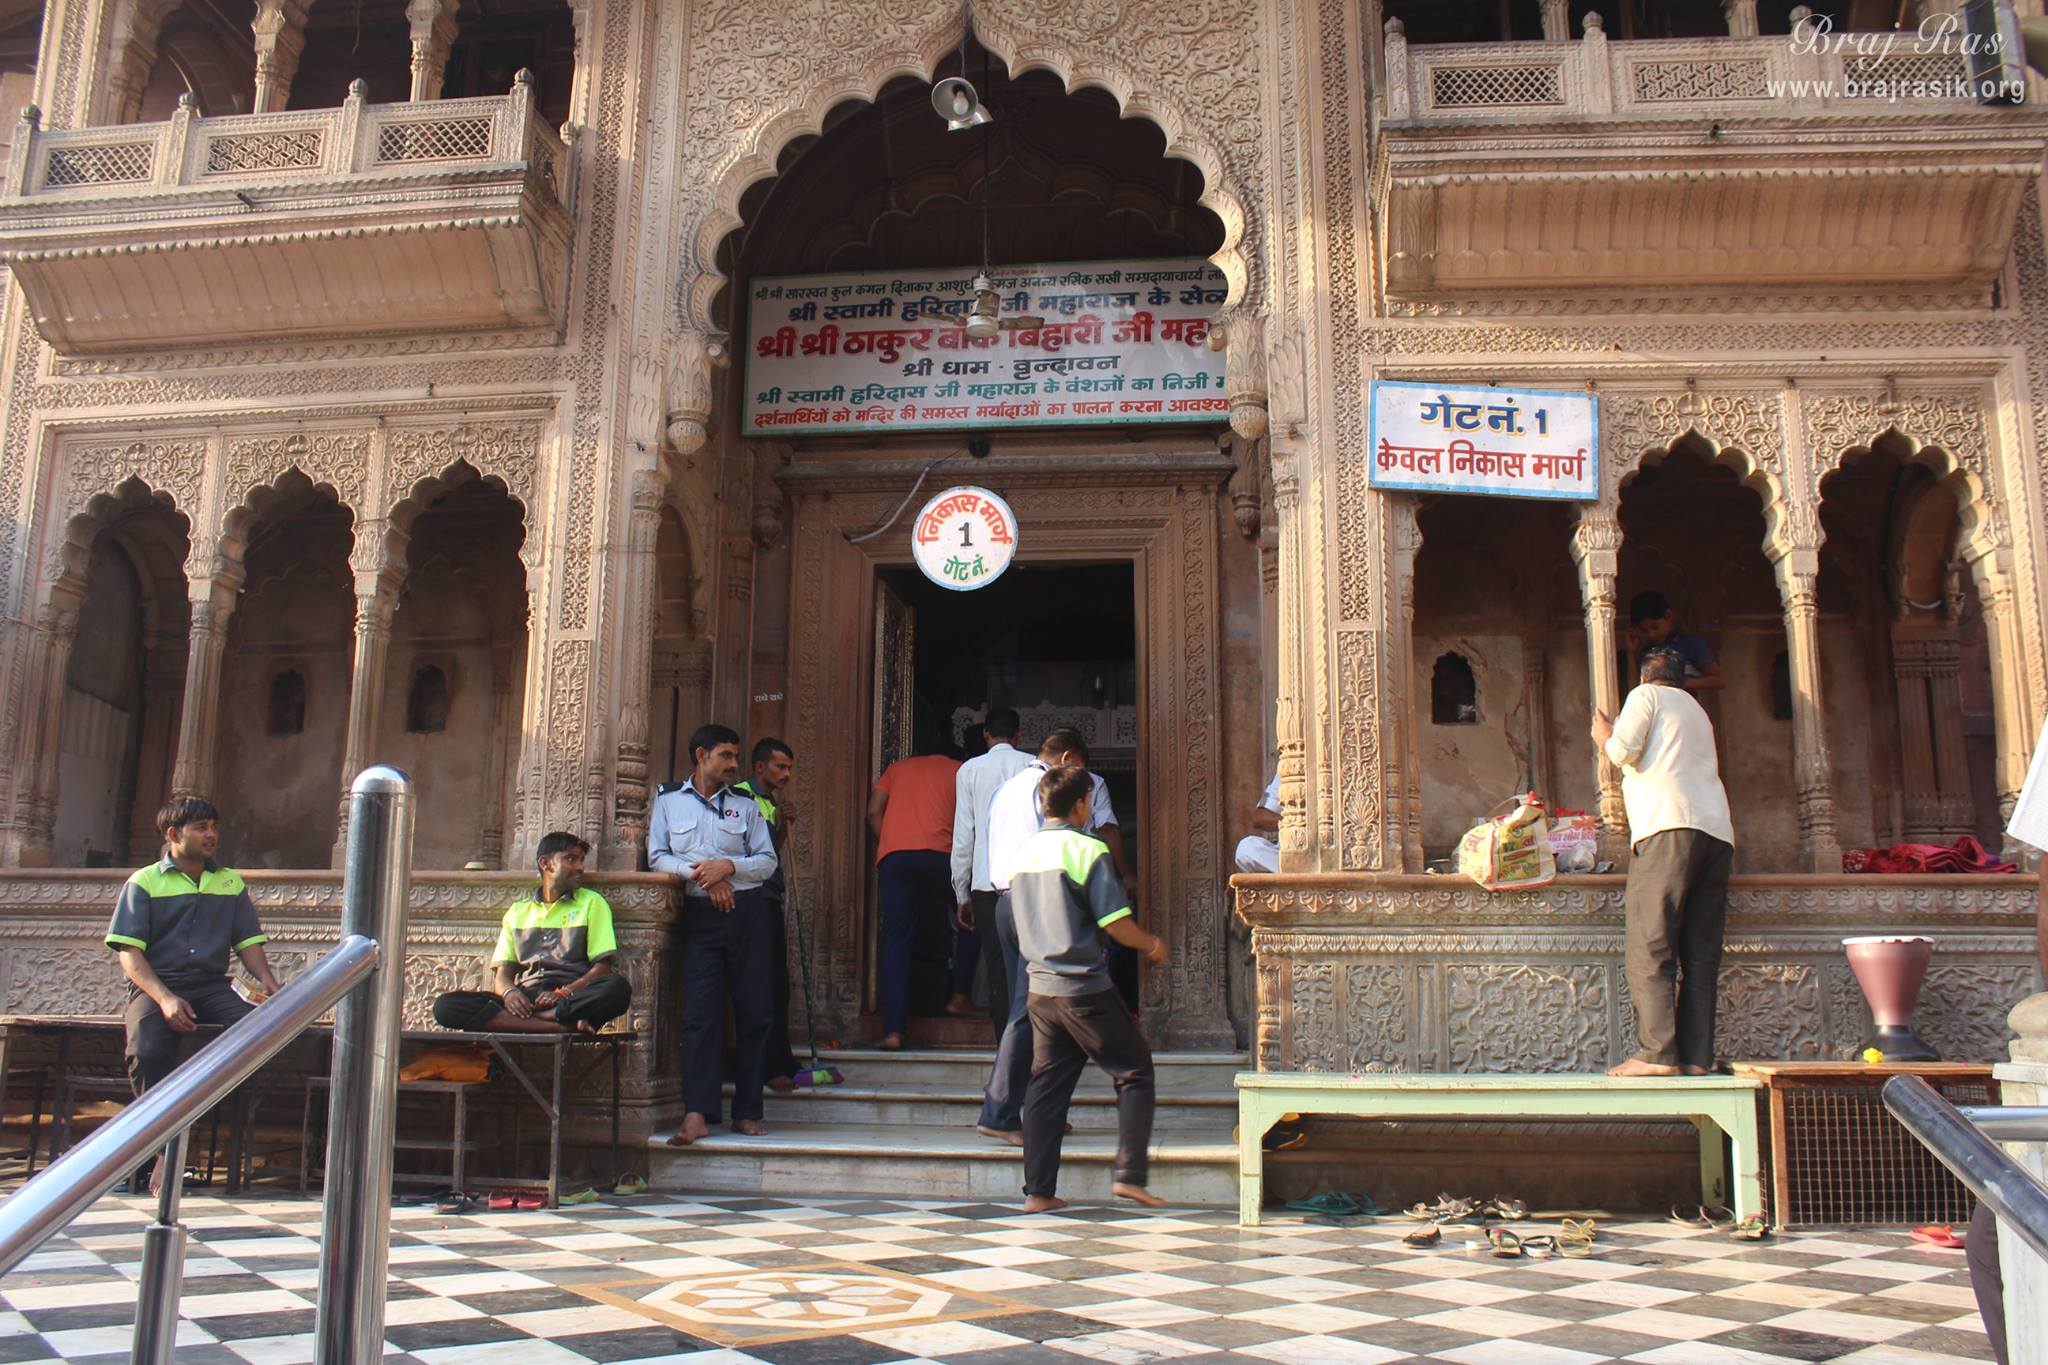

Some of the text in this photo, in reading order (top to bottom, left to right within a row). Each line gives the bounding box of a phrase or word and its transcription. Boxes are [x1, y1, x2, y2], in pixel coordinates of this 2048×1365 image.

[856, 284, 886, 295] कमल
[1060, 272, 1093, 286] रसिक
[788, 301, 818, 322] श्री
[824, 297, 895, 321] स्वामी
[902, 295, 978, 322] हरिदा
[1001, 291, 1031, 312] जी
[1039, 291, 1139, 315] महाराज
[1147, 286, 1171, 305] के
[756, 325, 798, 358] श्री
[799, 323, 841, 356] श्री
[843, 328, 933, 364] ठाकुर
[1112, 311, 1156, 344] जी
[902, 358, 934, 377] श्री
[942, 360, 992, 376] धाम
[1013, 355, 1121, 380] वृन्दावन
[756, 386, 782, 404] श्री
[787, 385, 846, 403] स्वामी
[850, 382, 928, 405] हरिदास
[934, 379, 962, 398] जी
[967, 381, 1037, 400] महाराज
[1043, 378, 1060, 394] के
[1065, 373, 1126, 392] वंशजों
[1131, 376, 1154, 391] का
[1162, 371, 1209, 391] निजी
[832, 406, 851, 423] को
[855, 405, 896, 424] मन्दिर
[900, 405, 916, 420] की
[922, 405, 970, 420] समस्त
[976, 399, 1042, 420] मर्यादाओं
[1047, 402, 1065, 416] का
[1072, 401, 1114, 415] पालन
[1119, 399, 1162, 414] करना
[1168, 398, 1232, 413] आवश्य
[1420, 394, 1548, 435] गेट नं. 1
[1377, 437, 1587, 481] केवल निकास मार्ग
[917, 494, 1013, 546] निकास मार्ग
[958, 521, 973, 547] 1
[943, 555, 971, 581] गेट
